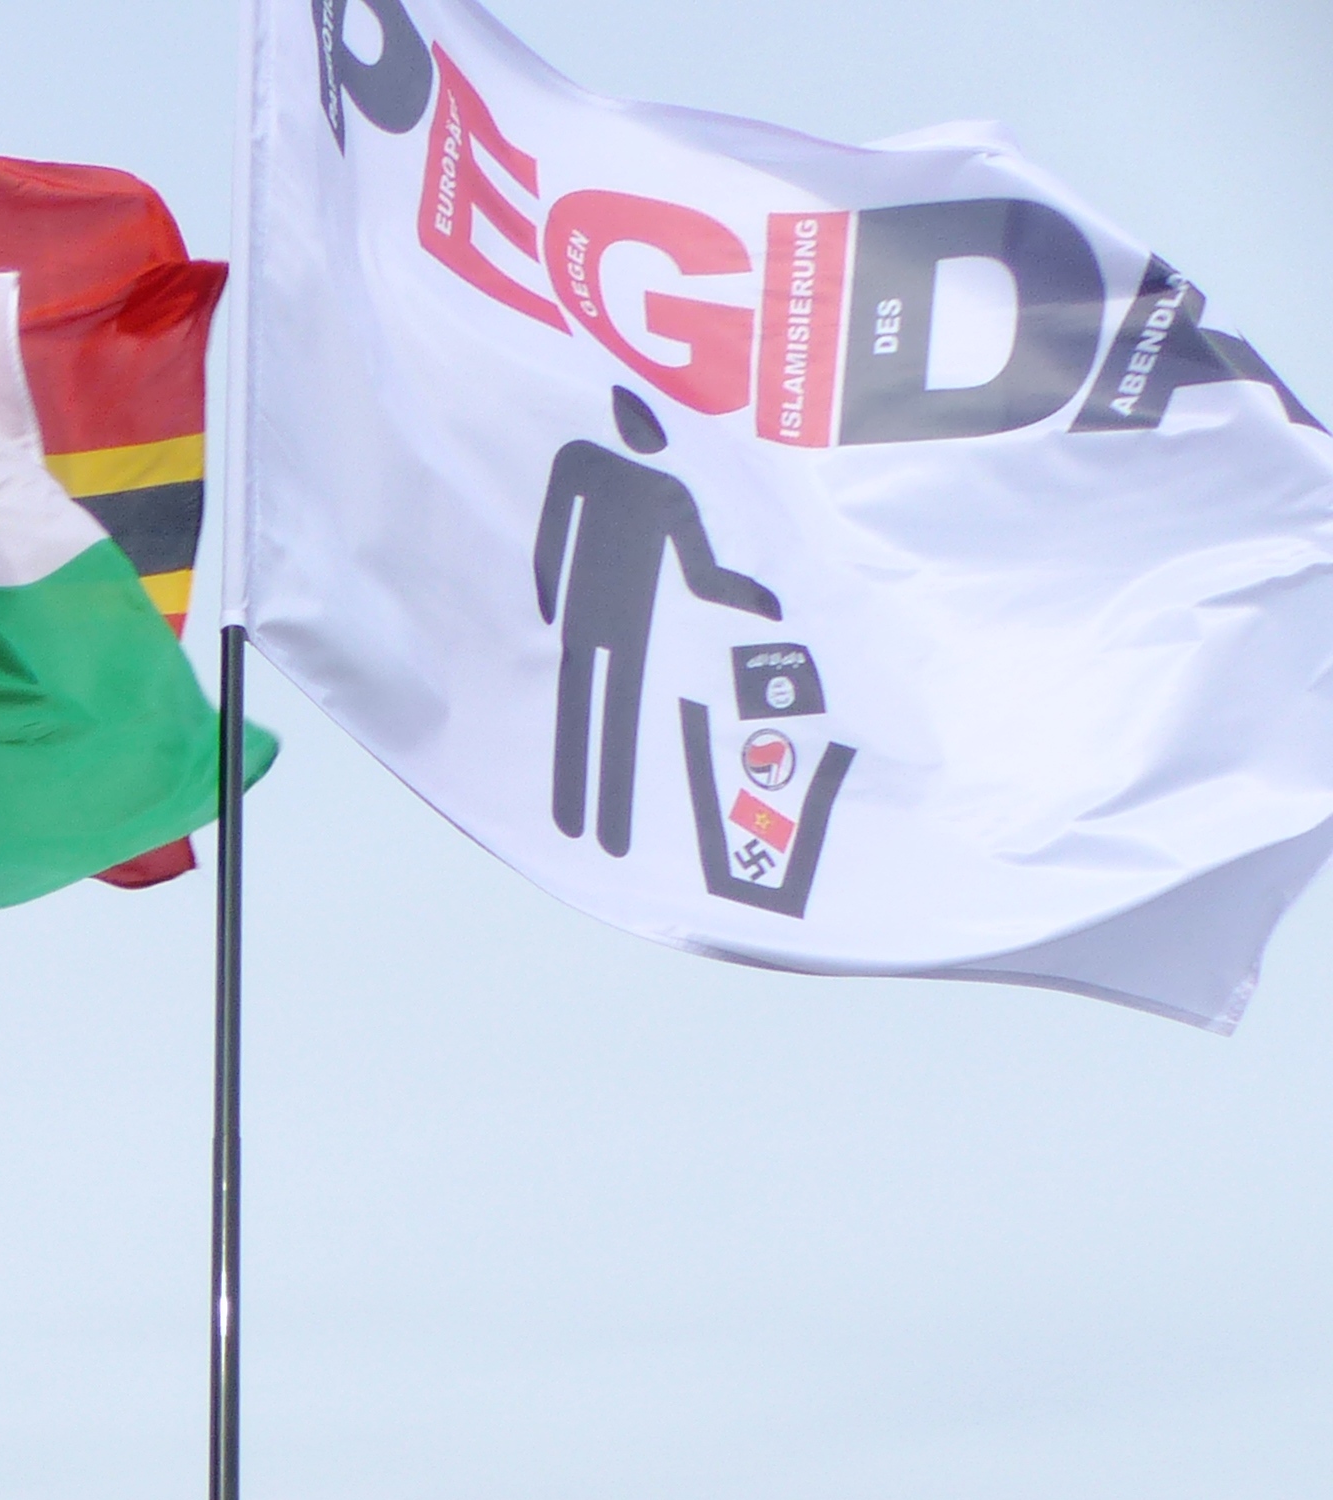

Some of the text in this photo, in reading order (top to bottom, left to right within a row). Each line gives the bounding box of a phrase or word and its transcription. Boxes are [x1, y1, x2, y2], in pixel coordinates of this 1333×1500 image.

[566, 229, 599, 319] GEGEN
[780, 218, 819, 438] ISLAMISIERUNG
[873, 298, 903, 356] DES
